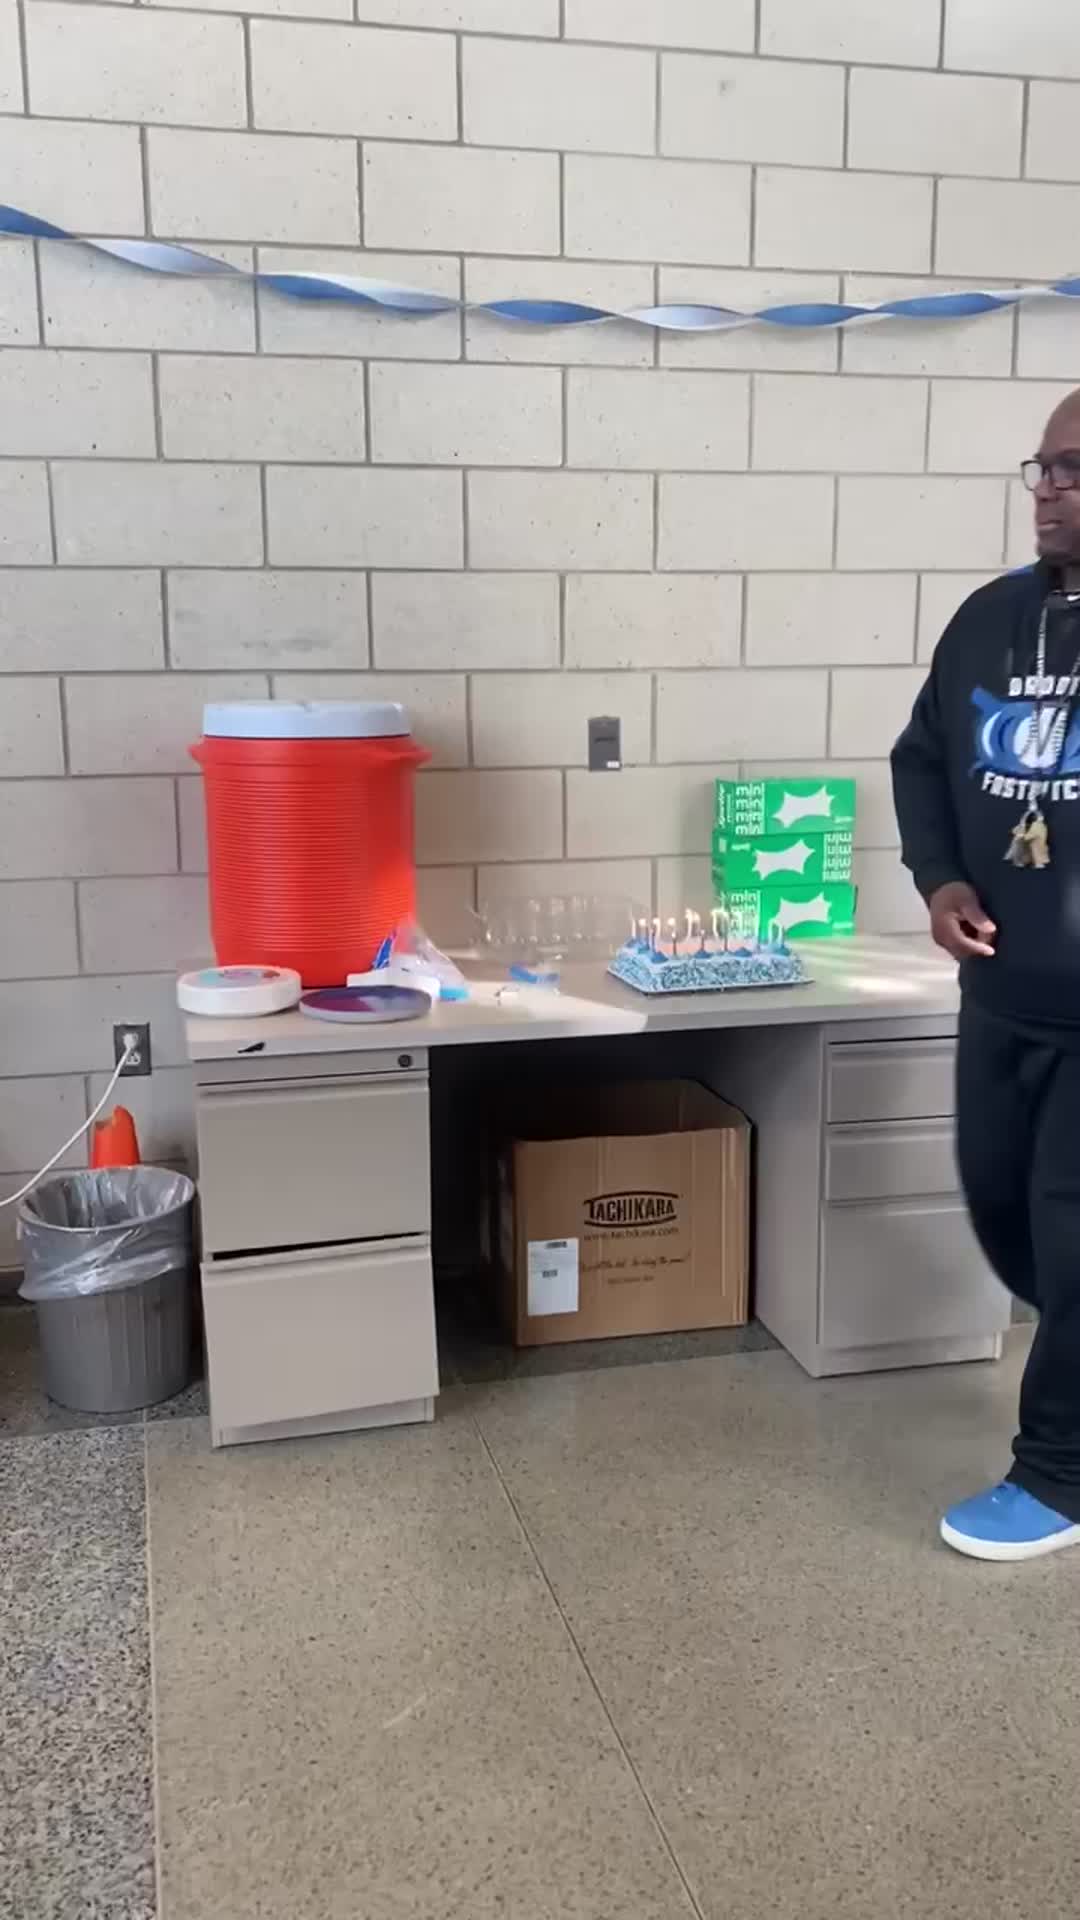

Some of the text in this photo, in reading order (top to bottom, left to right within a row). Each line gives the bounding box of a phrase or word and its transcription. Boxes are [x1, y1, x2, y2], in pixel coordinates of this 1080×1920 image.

[735, 783, 765, 797] mini
[981, 772, 1080, 801] FASTPITC
[735, 797, 765, 810] mini
[584, 1198, 675, 1222] TACHIKARA
